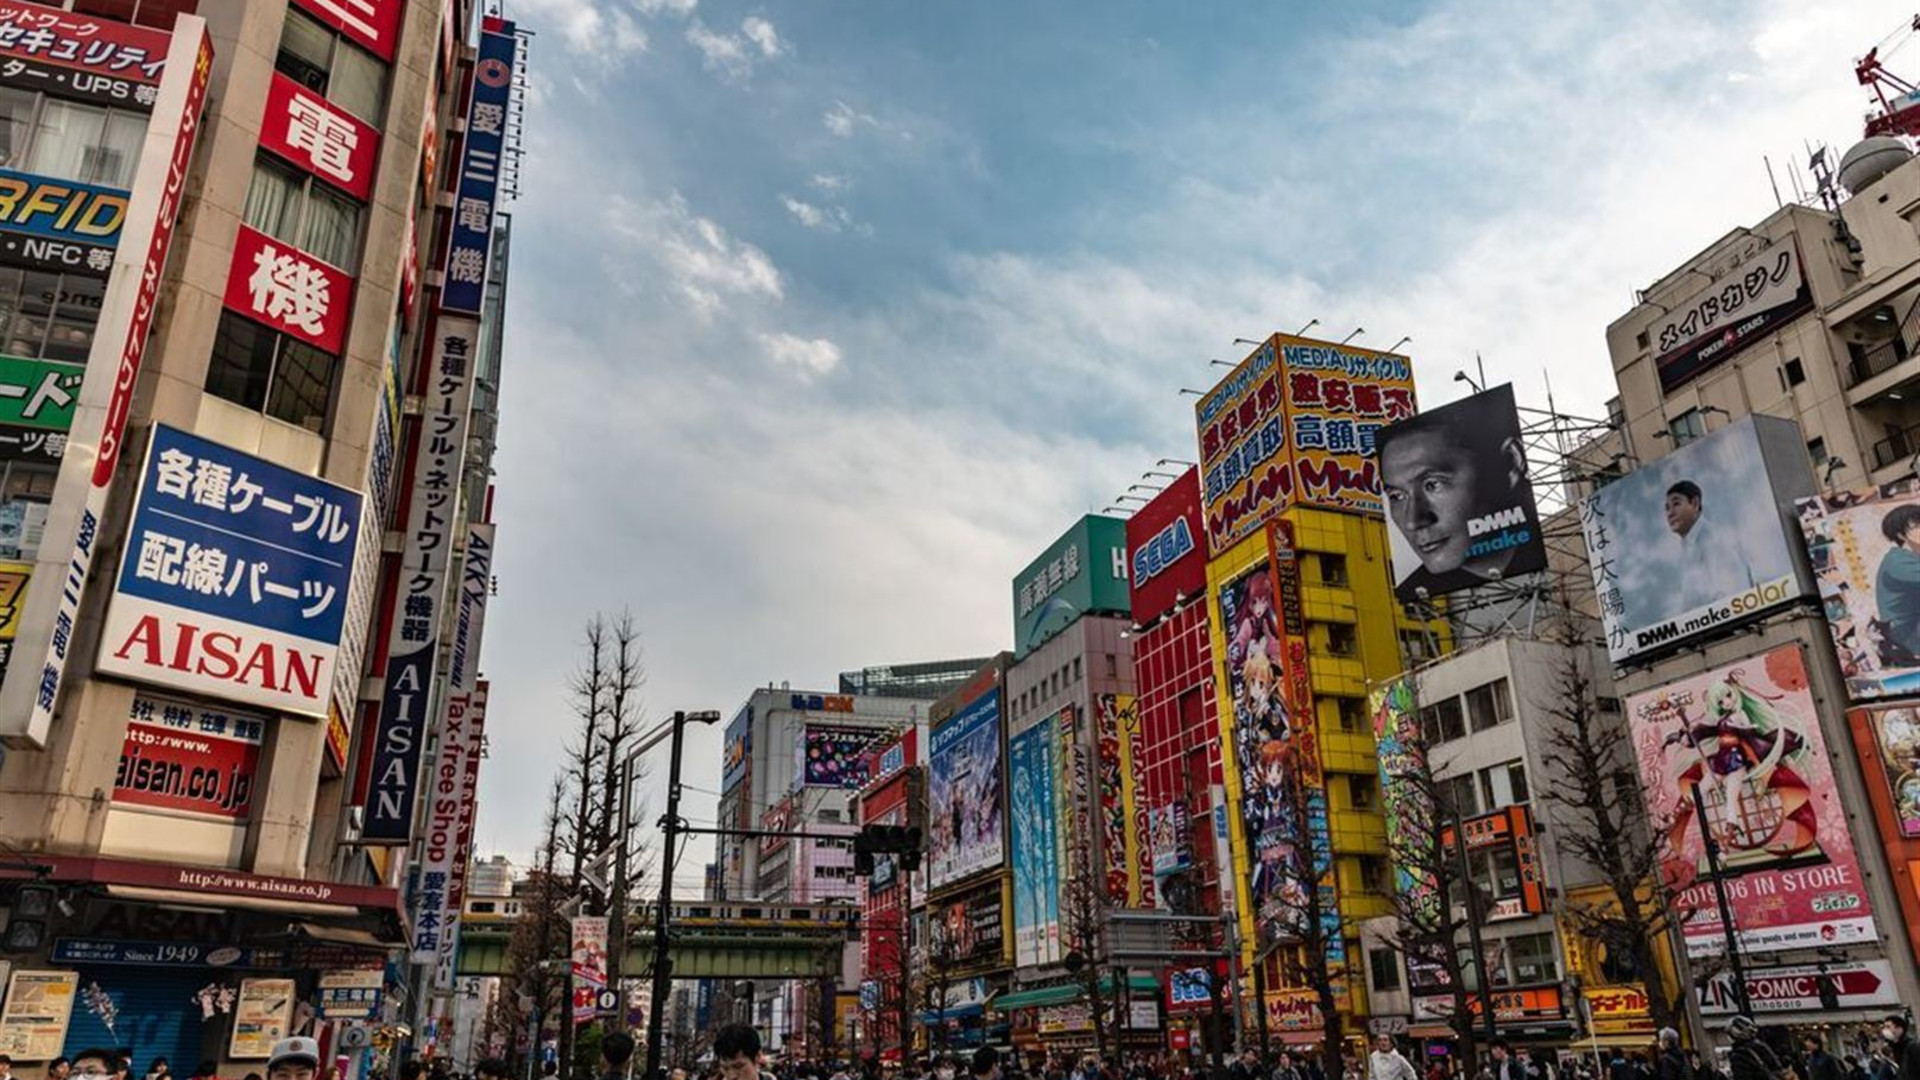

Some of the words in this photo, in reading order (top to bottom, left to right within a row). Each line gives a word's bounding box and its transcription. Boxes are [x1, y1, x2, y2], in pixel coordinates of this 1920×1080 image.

[449, 101, 504, 285] 愛三電機
[87, 248, 113, 271] 等
[1659, 250, 1790, 352] メイドカジノ
[44, 432, 68, 458] 等
[1293, 414, 1383, 457] 高額買
[156, 448, 350, 544] 各種ケーブル
[401, 335, 470, 643] 各種ケーブル・ネットワーク機器
[1298, 457, 1384, 500] Mul
[1132, 514, 1196, 590] SEGA
[1466, 505, 1528, 538] DMM
[136, 530, 336, 619] 配線パーツ
[463, 530, 491, 608] AKKY
[1580, 496, 1636, 657] 次は太陽か。
[1730, 578, 1790, 614] solar
[113, 614, 325, 699] AISAN
[374, 663, 421, 820] AISAN
[438, 691, 472, 795] Tax-free
[427, 800, 458, 864] Shop
[178, 870, 332, 899] http://www.aisan.co.jp
[1138, 847, 1156, 909] Sho
[1754, 876, 1776, 897] IN
[1782, 864, 1853, 893] STORE
[123, 950, 154, 963] Since
[155, 944, 201, 964] 1949
[1744, 976, 1810, 1000] COMIC
[1752, 1000, 1803, 1010] kihabara
